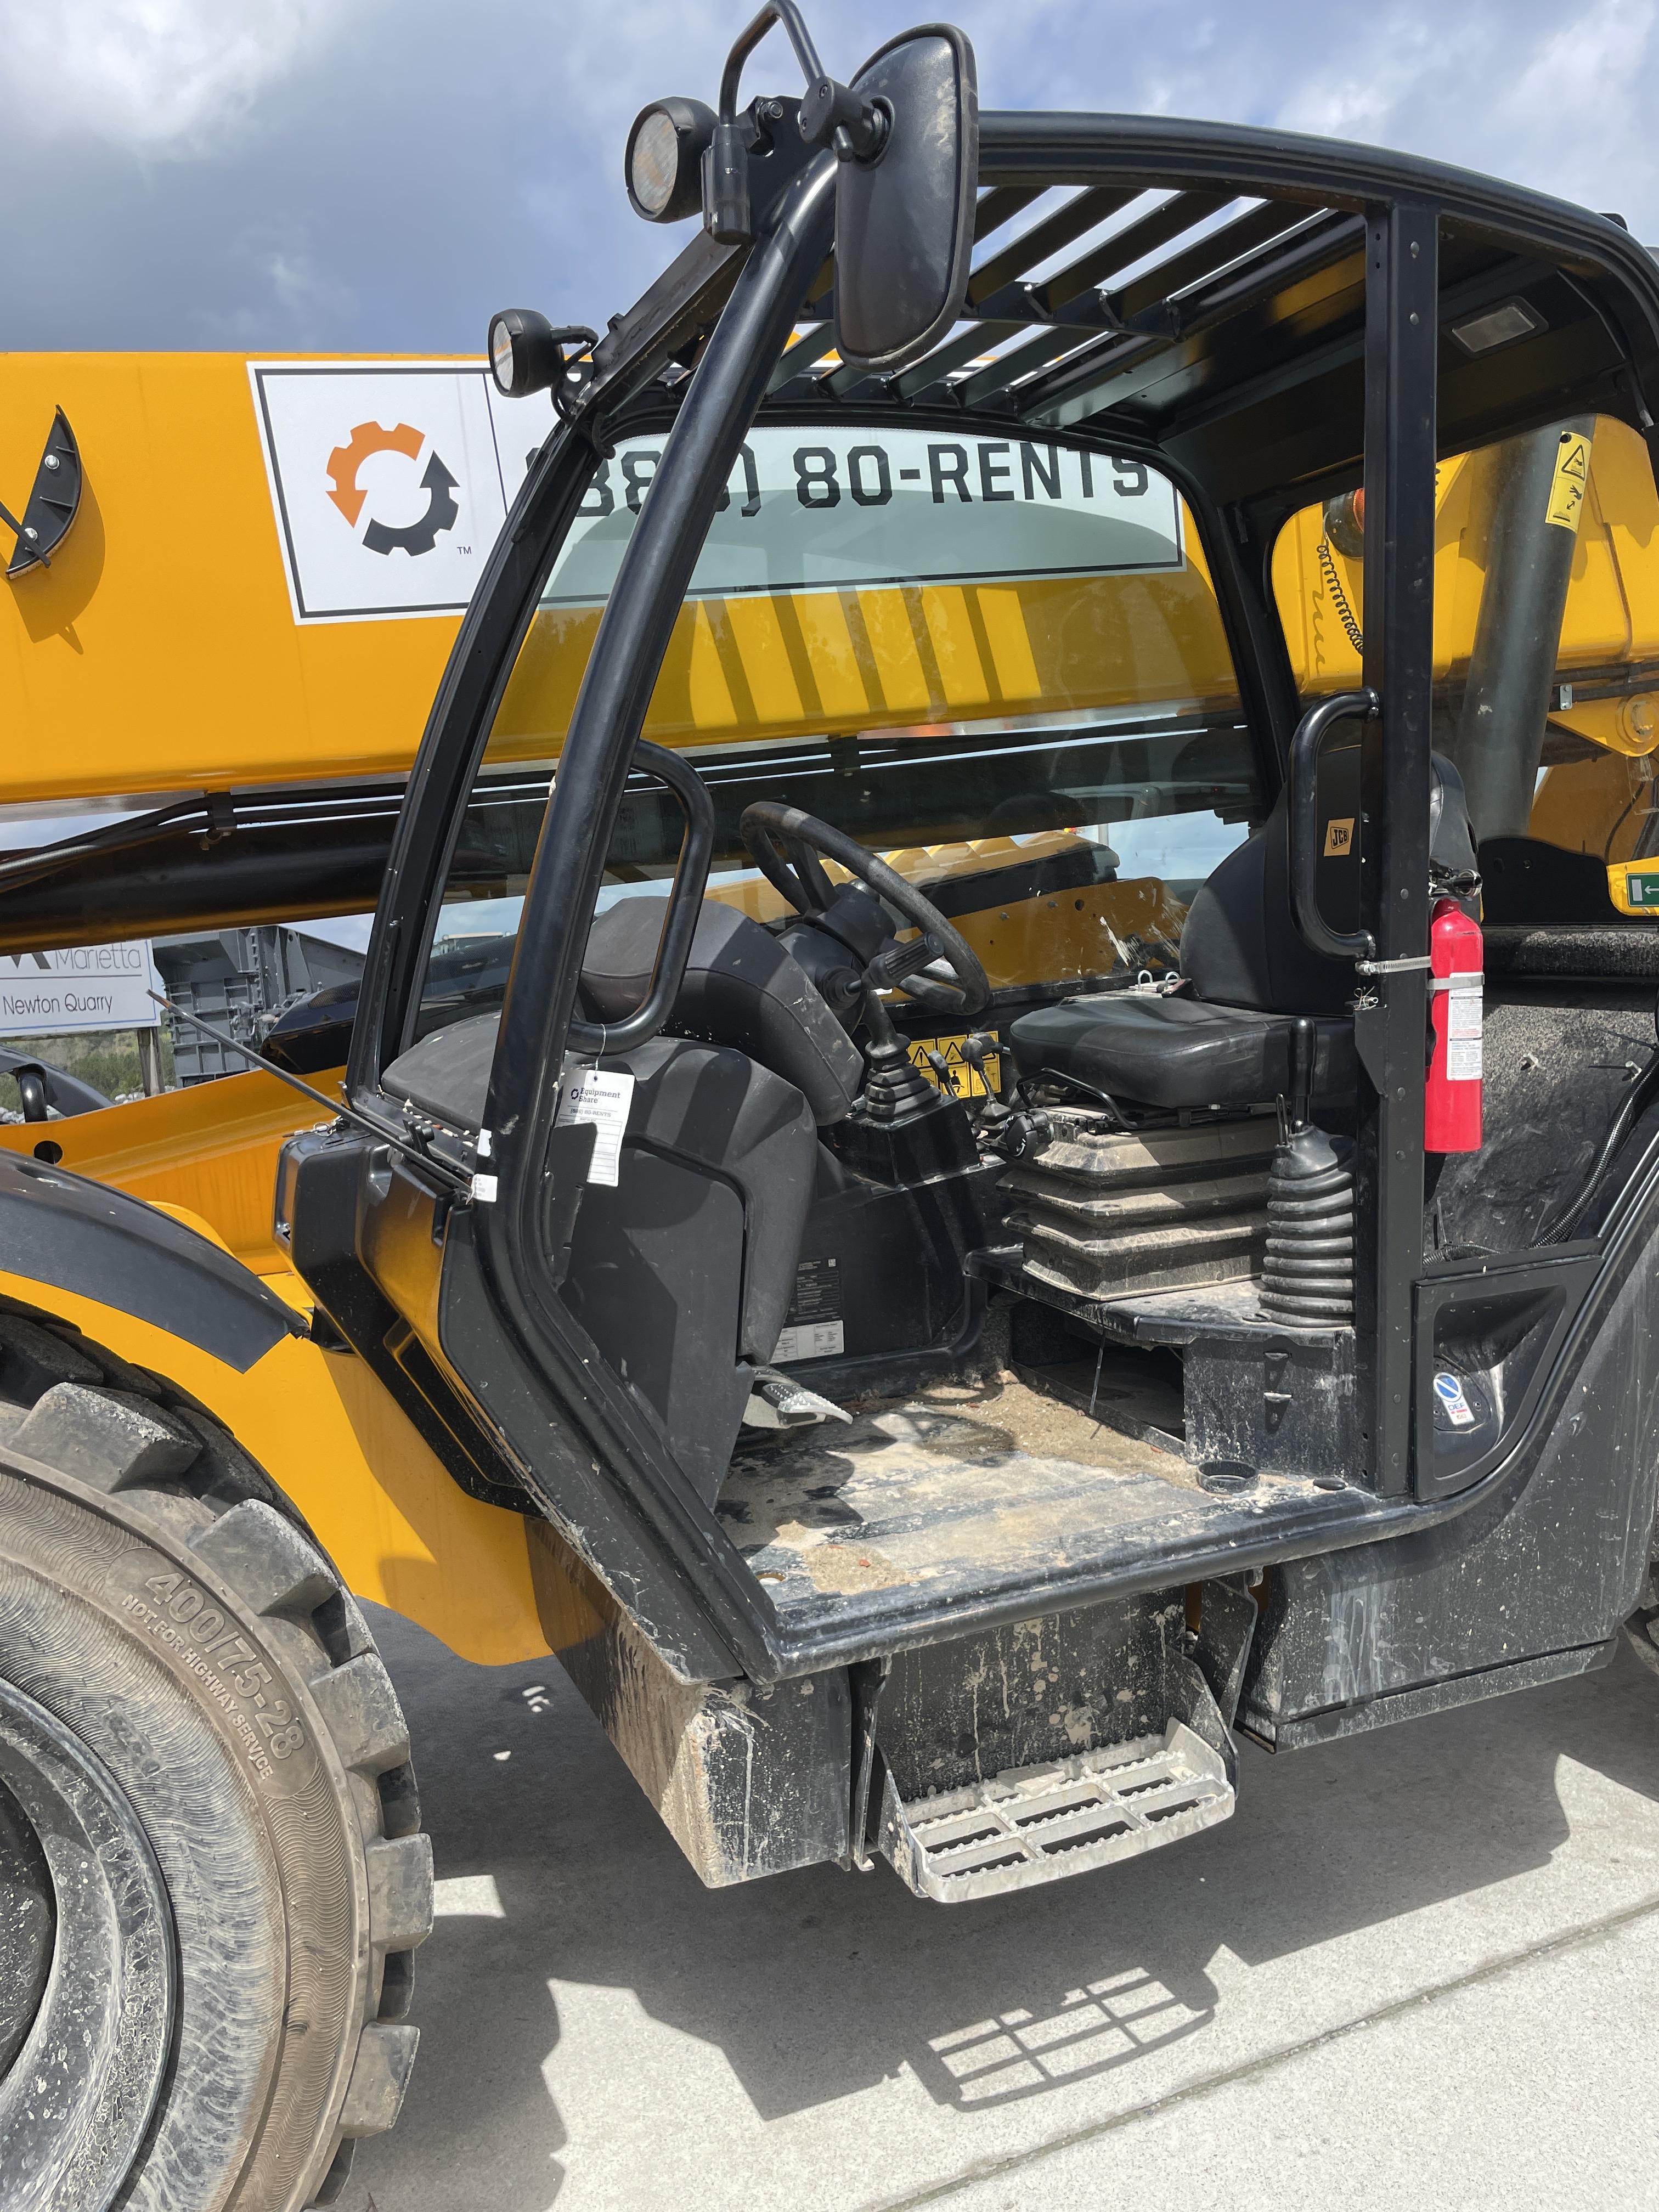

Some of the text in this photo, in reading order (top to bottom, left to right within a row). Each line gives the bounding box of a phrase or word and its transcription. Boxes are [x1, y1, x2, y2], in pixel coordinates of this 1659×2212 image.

[456, 546, 472, 555] TM
[1333, 829, 1348, 847] JCB
[55, 943, 142, 970] Marietta
[3, 993, 112, 1015] Newton Quarry
[578, 1095, 599, 1104] Share
[580, 1087, 621, 1099] Equipment
[121, 1594, 274, 1780] NOT FOR HIGHWAY SERVICE
